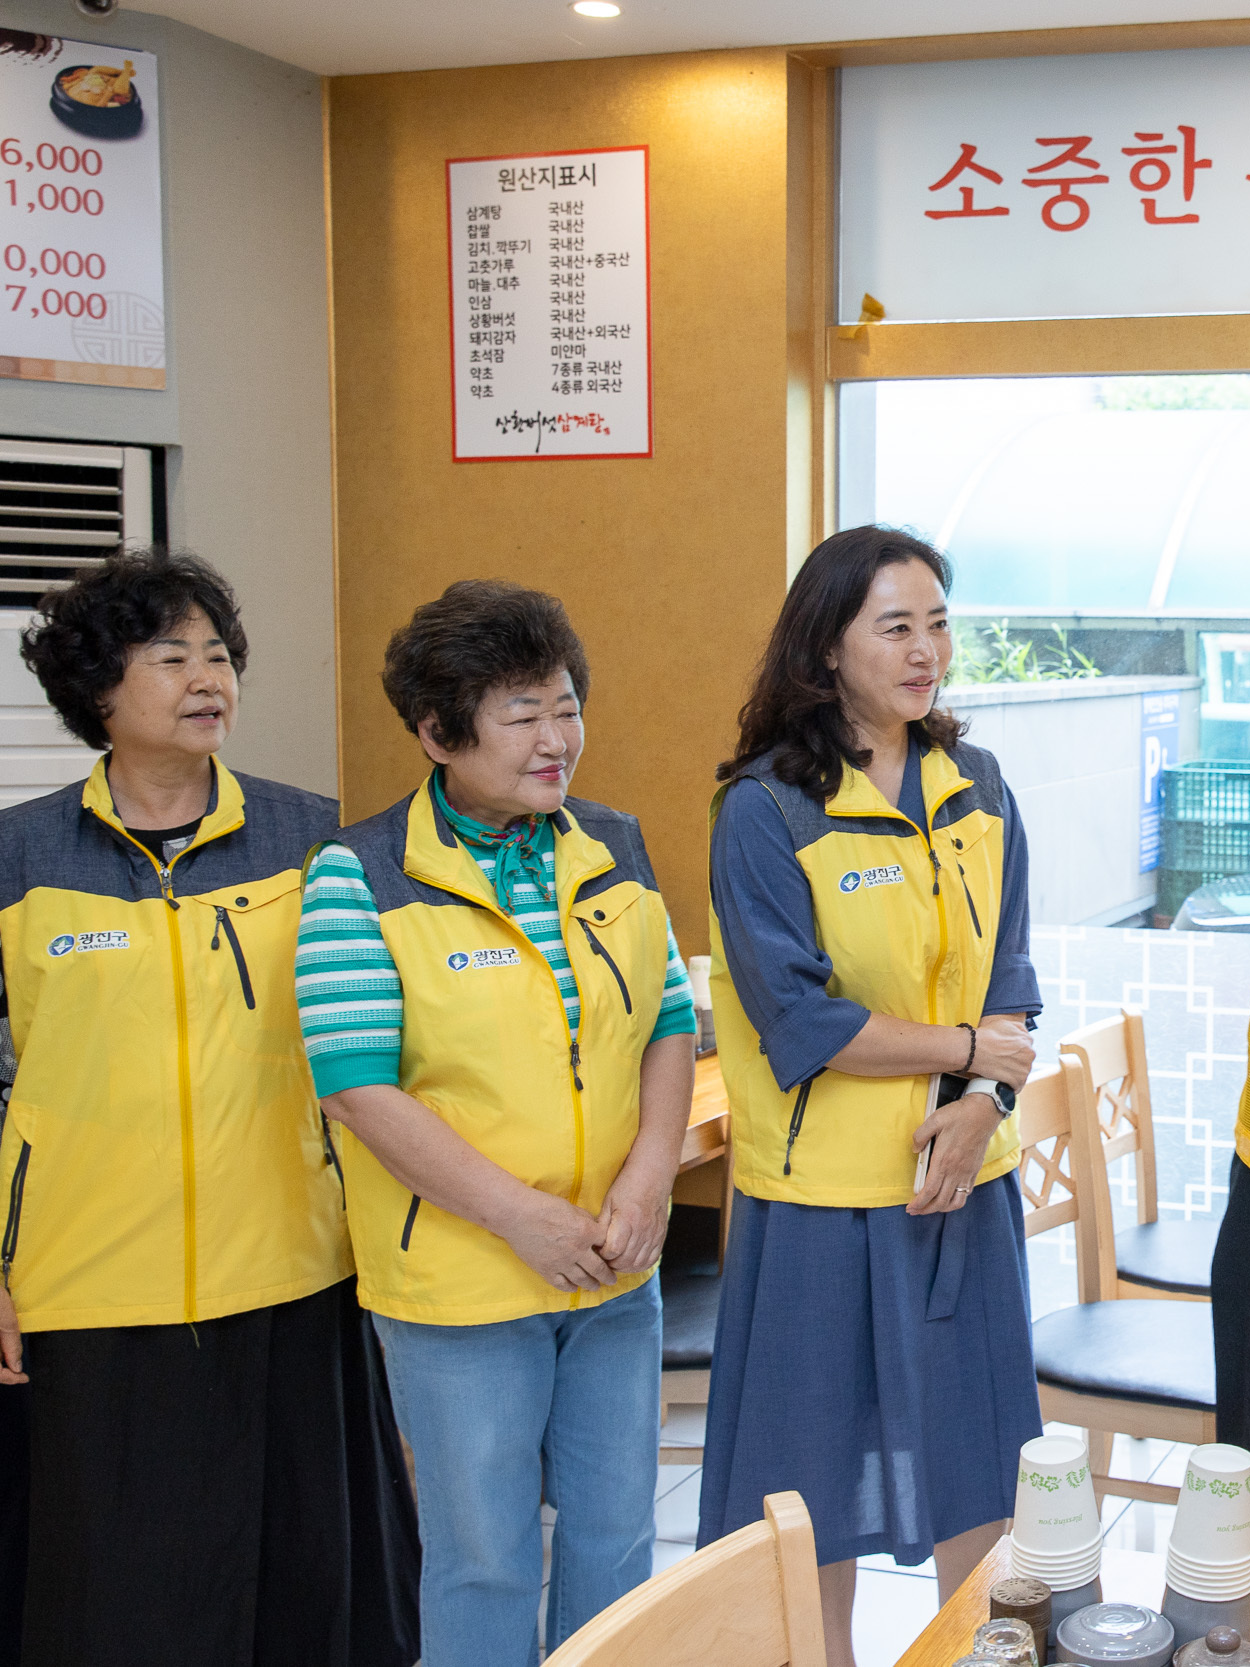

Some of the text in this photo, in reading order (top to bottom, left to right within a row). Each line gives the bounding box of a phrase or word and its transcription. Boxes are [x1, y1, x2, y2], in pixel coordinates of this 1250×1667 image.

[498, 163, 597, 193] 원산지표시
[924, 124, 1213, 232] 소중한
[467, 205, 501, 221] 삼계탕
[549, 201, 584, 216] 국내산
[468, 224, 490, 239] 찹쌀
[549, 219, 584, 234] 국내산
[549, 237, 584, 252] 국내산
[468, 259, 515, 274] 고춧가루
[550, 252, 630, 270] 국내산+중국산
[550, 272, 585, 287] 국내산
[469, 296, 492, 311] 인삼
[550, 291, 585, 305] 국내산
[469, 312, 515, 329] 상황버섯
[550, 309, 585, 324] 국내산
[470, 330, 516, 346] 돼지감자
[550, 324, 631, 341] 국내산+외국산
[551, 344, 586, 359] 미얀마
[471, 367, 494, 381] 약초
[551, 360, 622, 377] 7종류 국내산
[471, 385, 494, 399] 약초
[552, 379, 622, 395] 4종류 외국산
[1144, 736, 1160, 803] P
[863, 865, 901, 881] 광진구
[78, 931, 128, 945] 광진구
[473, 948, 516, 961] 광진구
